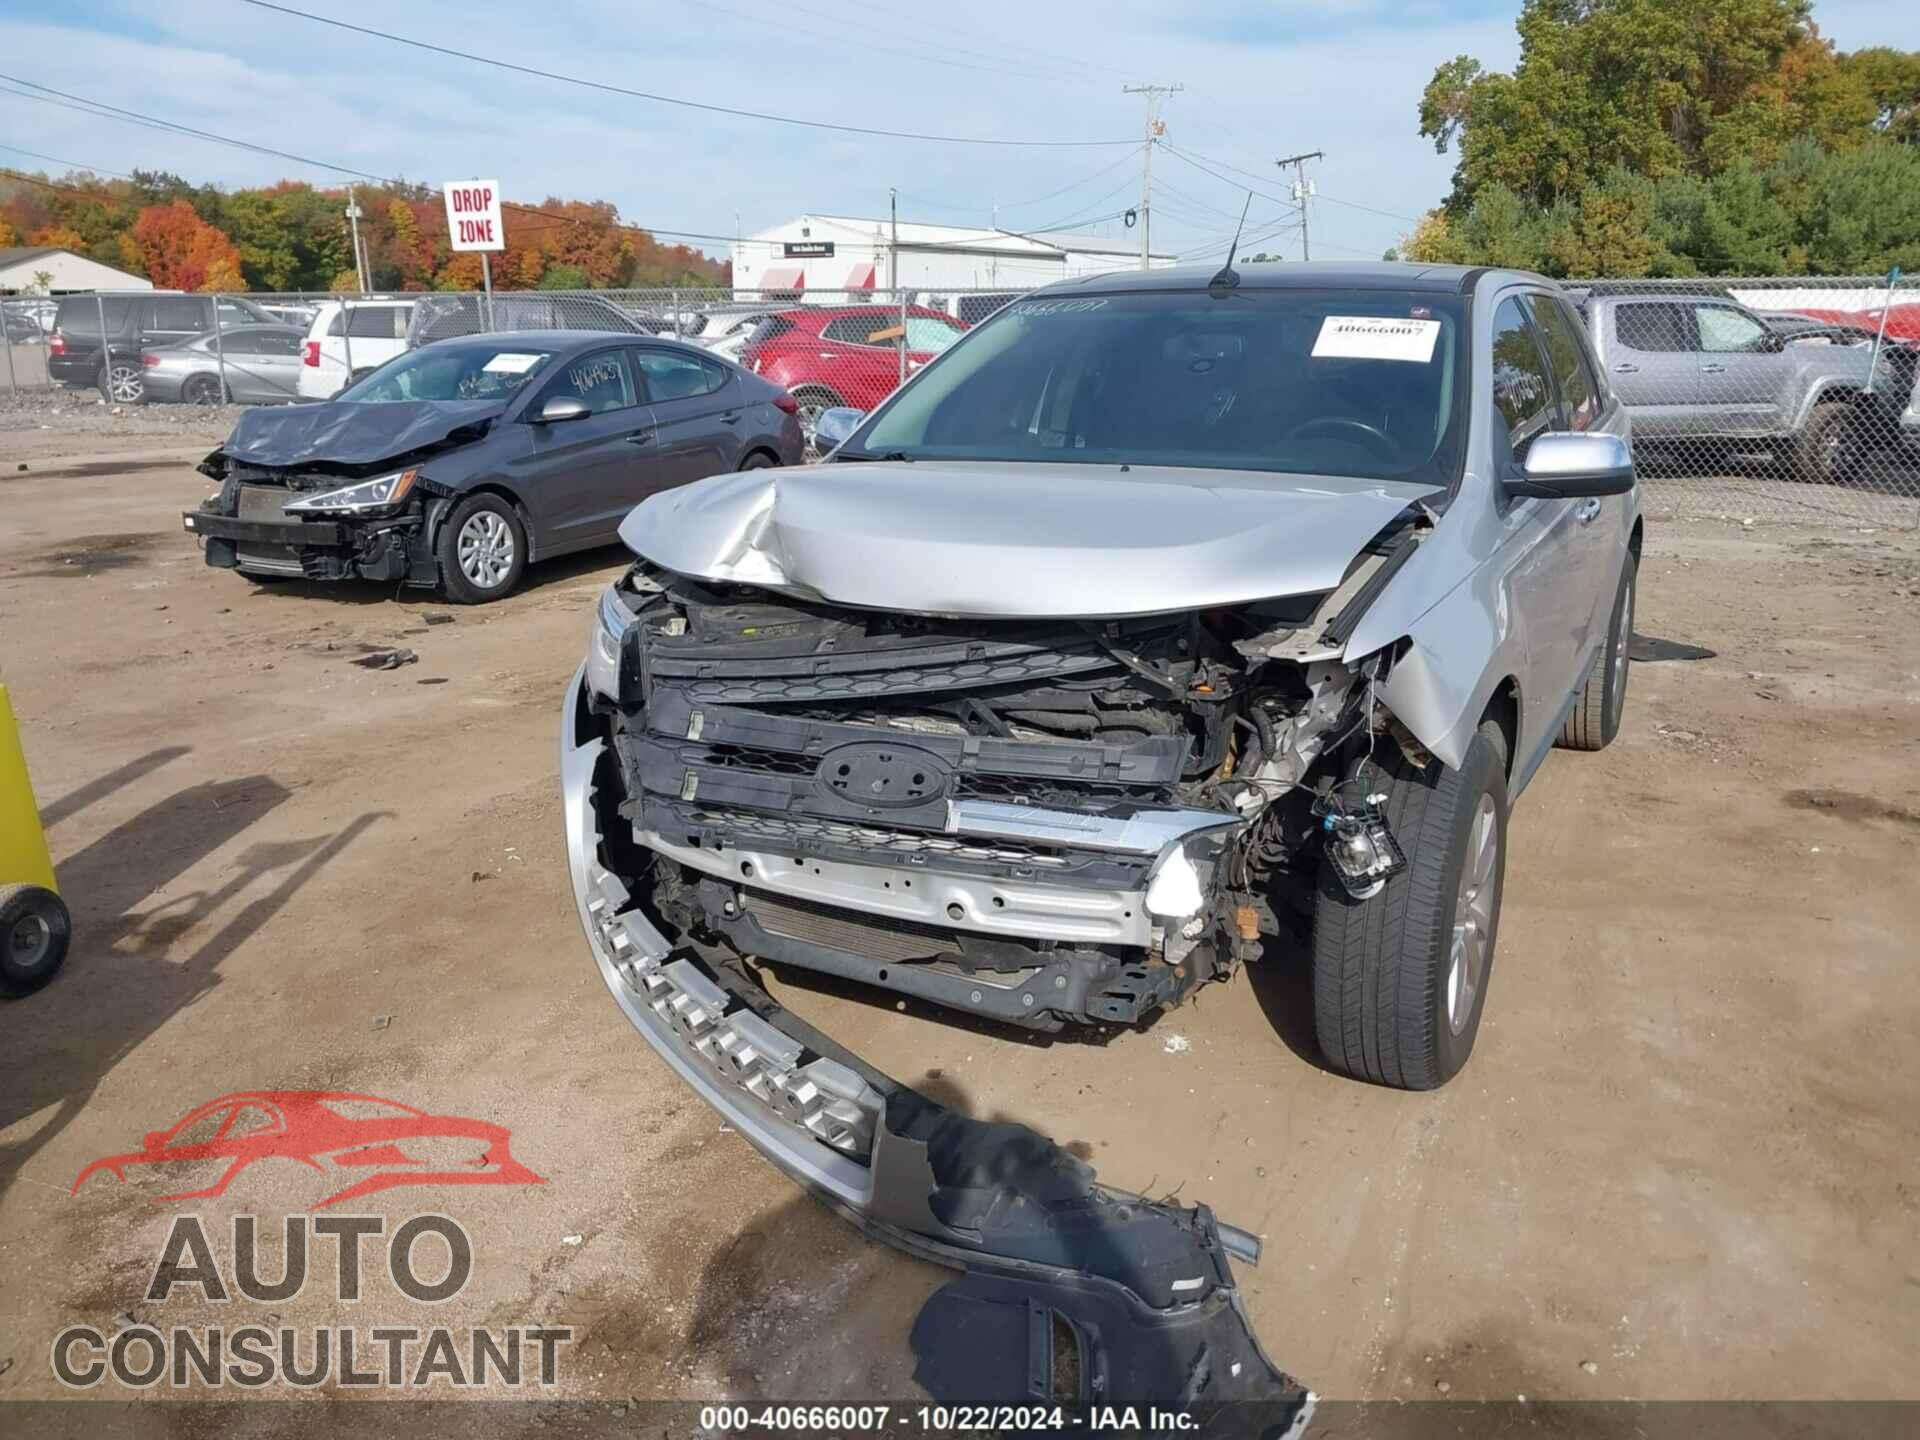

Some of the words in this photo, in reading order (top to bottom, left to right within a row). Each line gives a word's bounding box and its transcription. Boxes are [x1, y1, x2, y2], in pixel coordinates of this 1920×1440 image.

[452, 188, 492, 212] DROP
[458, 219, 494, 243] ZONE
[1333, 324, 1424, 336] 40666007
